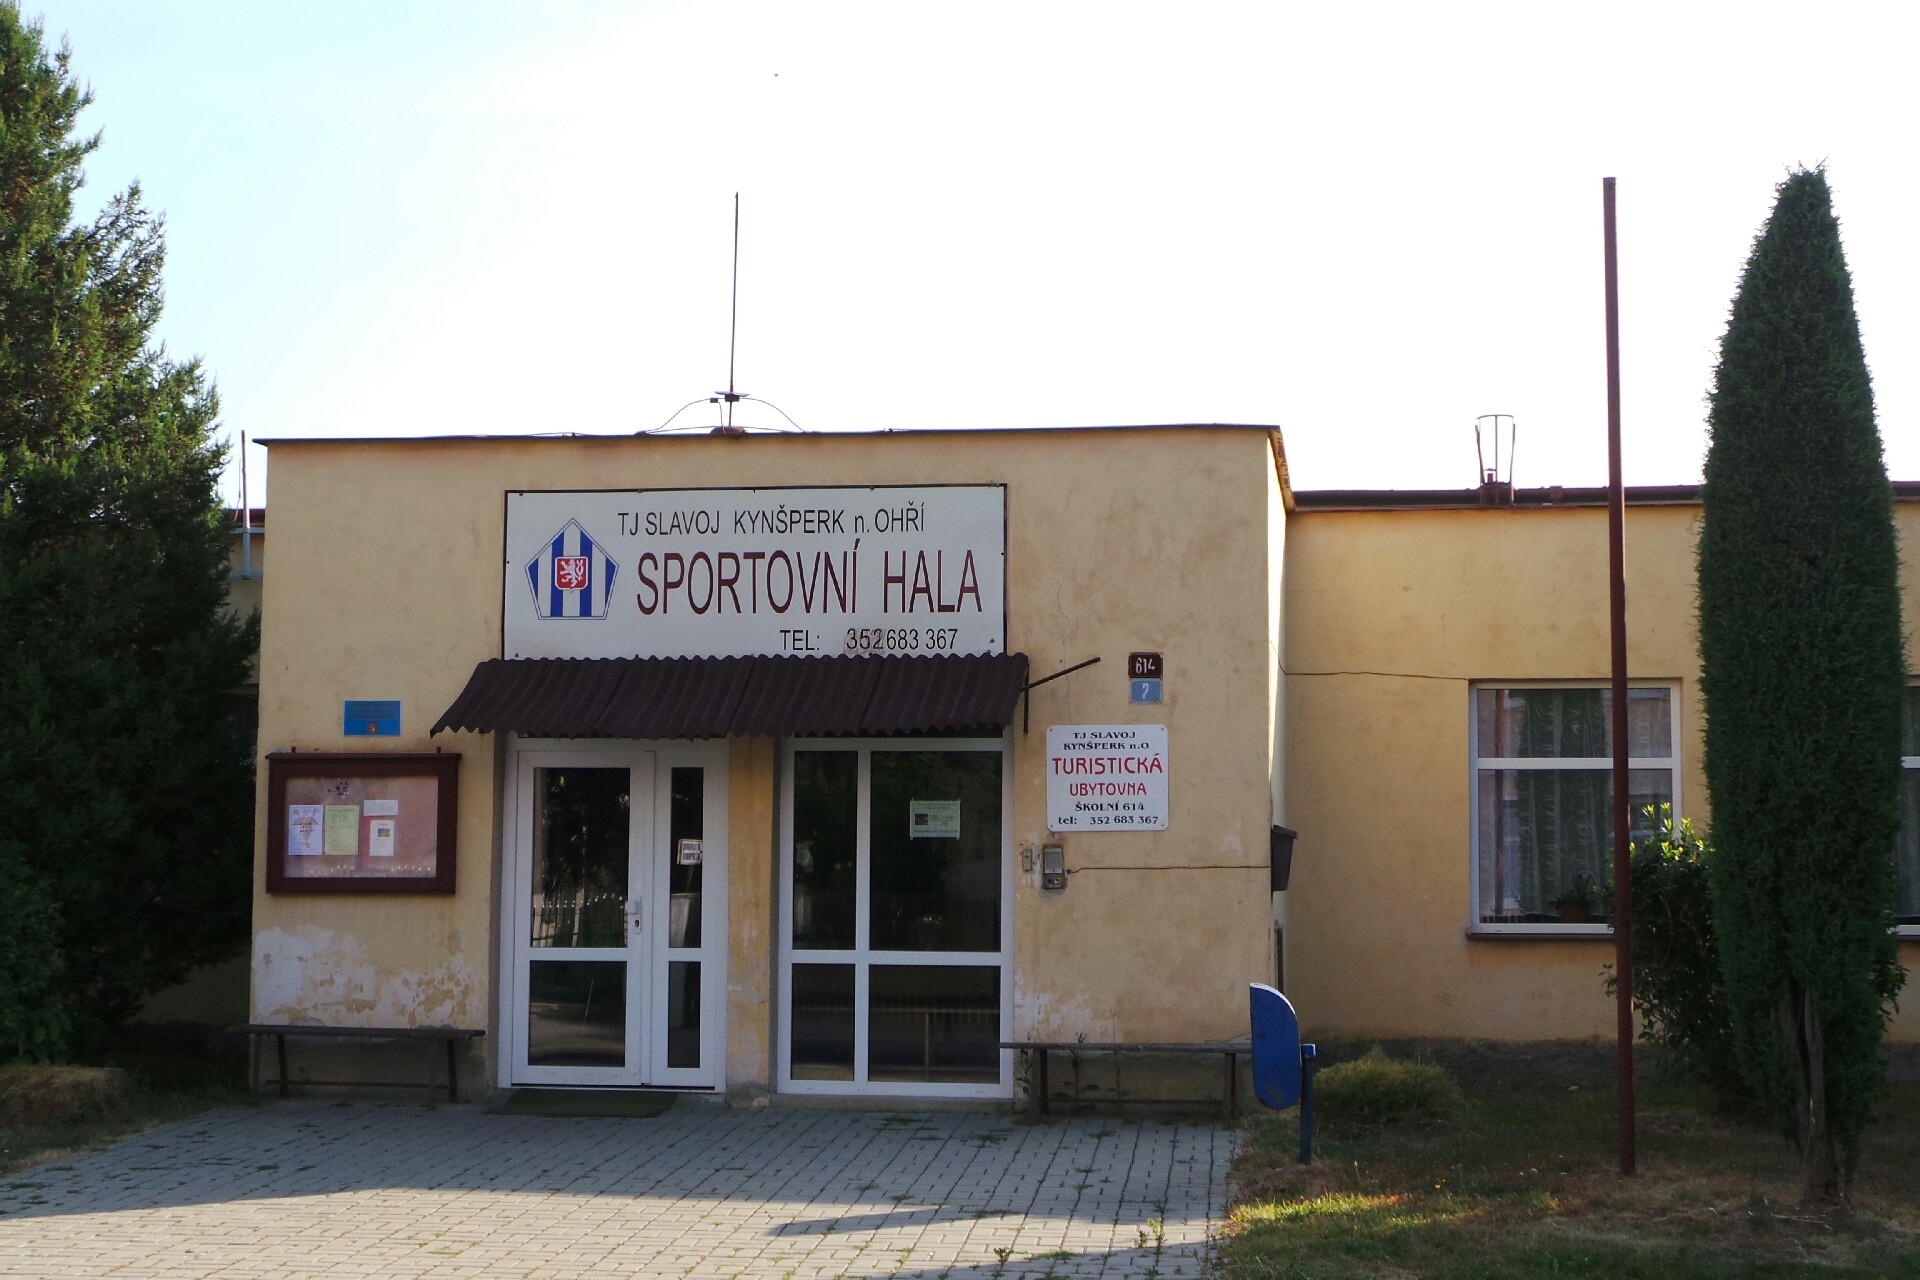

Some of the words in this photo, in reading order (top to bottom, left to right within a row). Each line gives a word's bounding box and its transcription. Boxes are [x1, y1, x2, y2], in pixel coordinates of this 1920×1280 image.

[617, 512, 639, 536] TJ
[645, 510, 720, 536] SLAVOJ
[733, 504, 845, 534] KYNŠPERK
[874, 501, 925, 533] OHŘÍ
[636, 538, 861, 616] SPORTOVNÍ
[883, 550, 983, 614] HALA
[779, 629, 820, 651] TEL:
[925, 628, 959, 650] 367
[1135, 657, 1156, 674] 614
[1142, 682, 1150, 700] 7
[1090, 731, 1136, 739] SLAVOJ
[1063, 741, 1126, 750] KYNŠPERK
[1052, 752, 1163, 775] TURISTICKÁ
[1069, 782, 1147, 797] UBYTOVNA
[1074, 800, 1120, 812] ŠKOLNÍ
[1122, 802, 1145, 812] 614
[1058, 816, 1078, 825] tel:
[1089, 816, 1111, 826] 352
[1113, 815, 1135, 824] 683
[1137, 816, 1159, 825] 367
